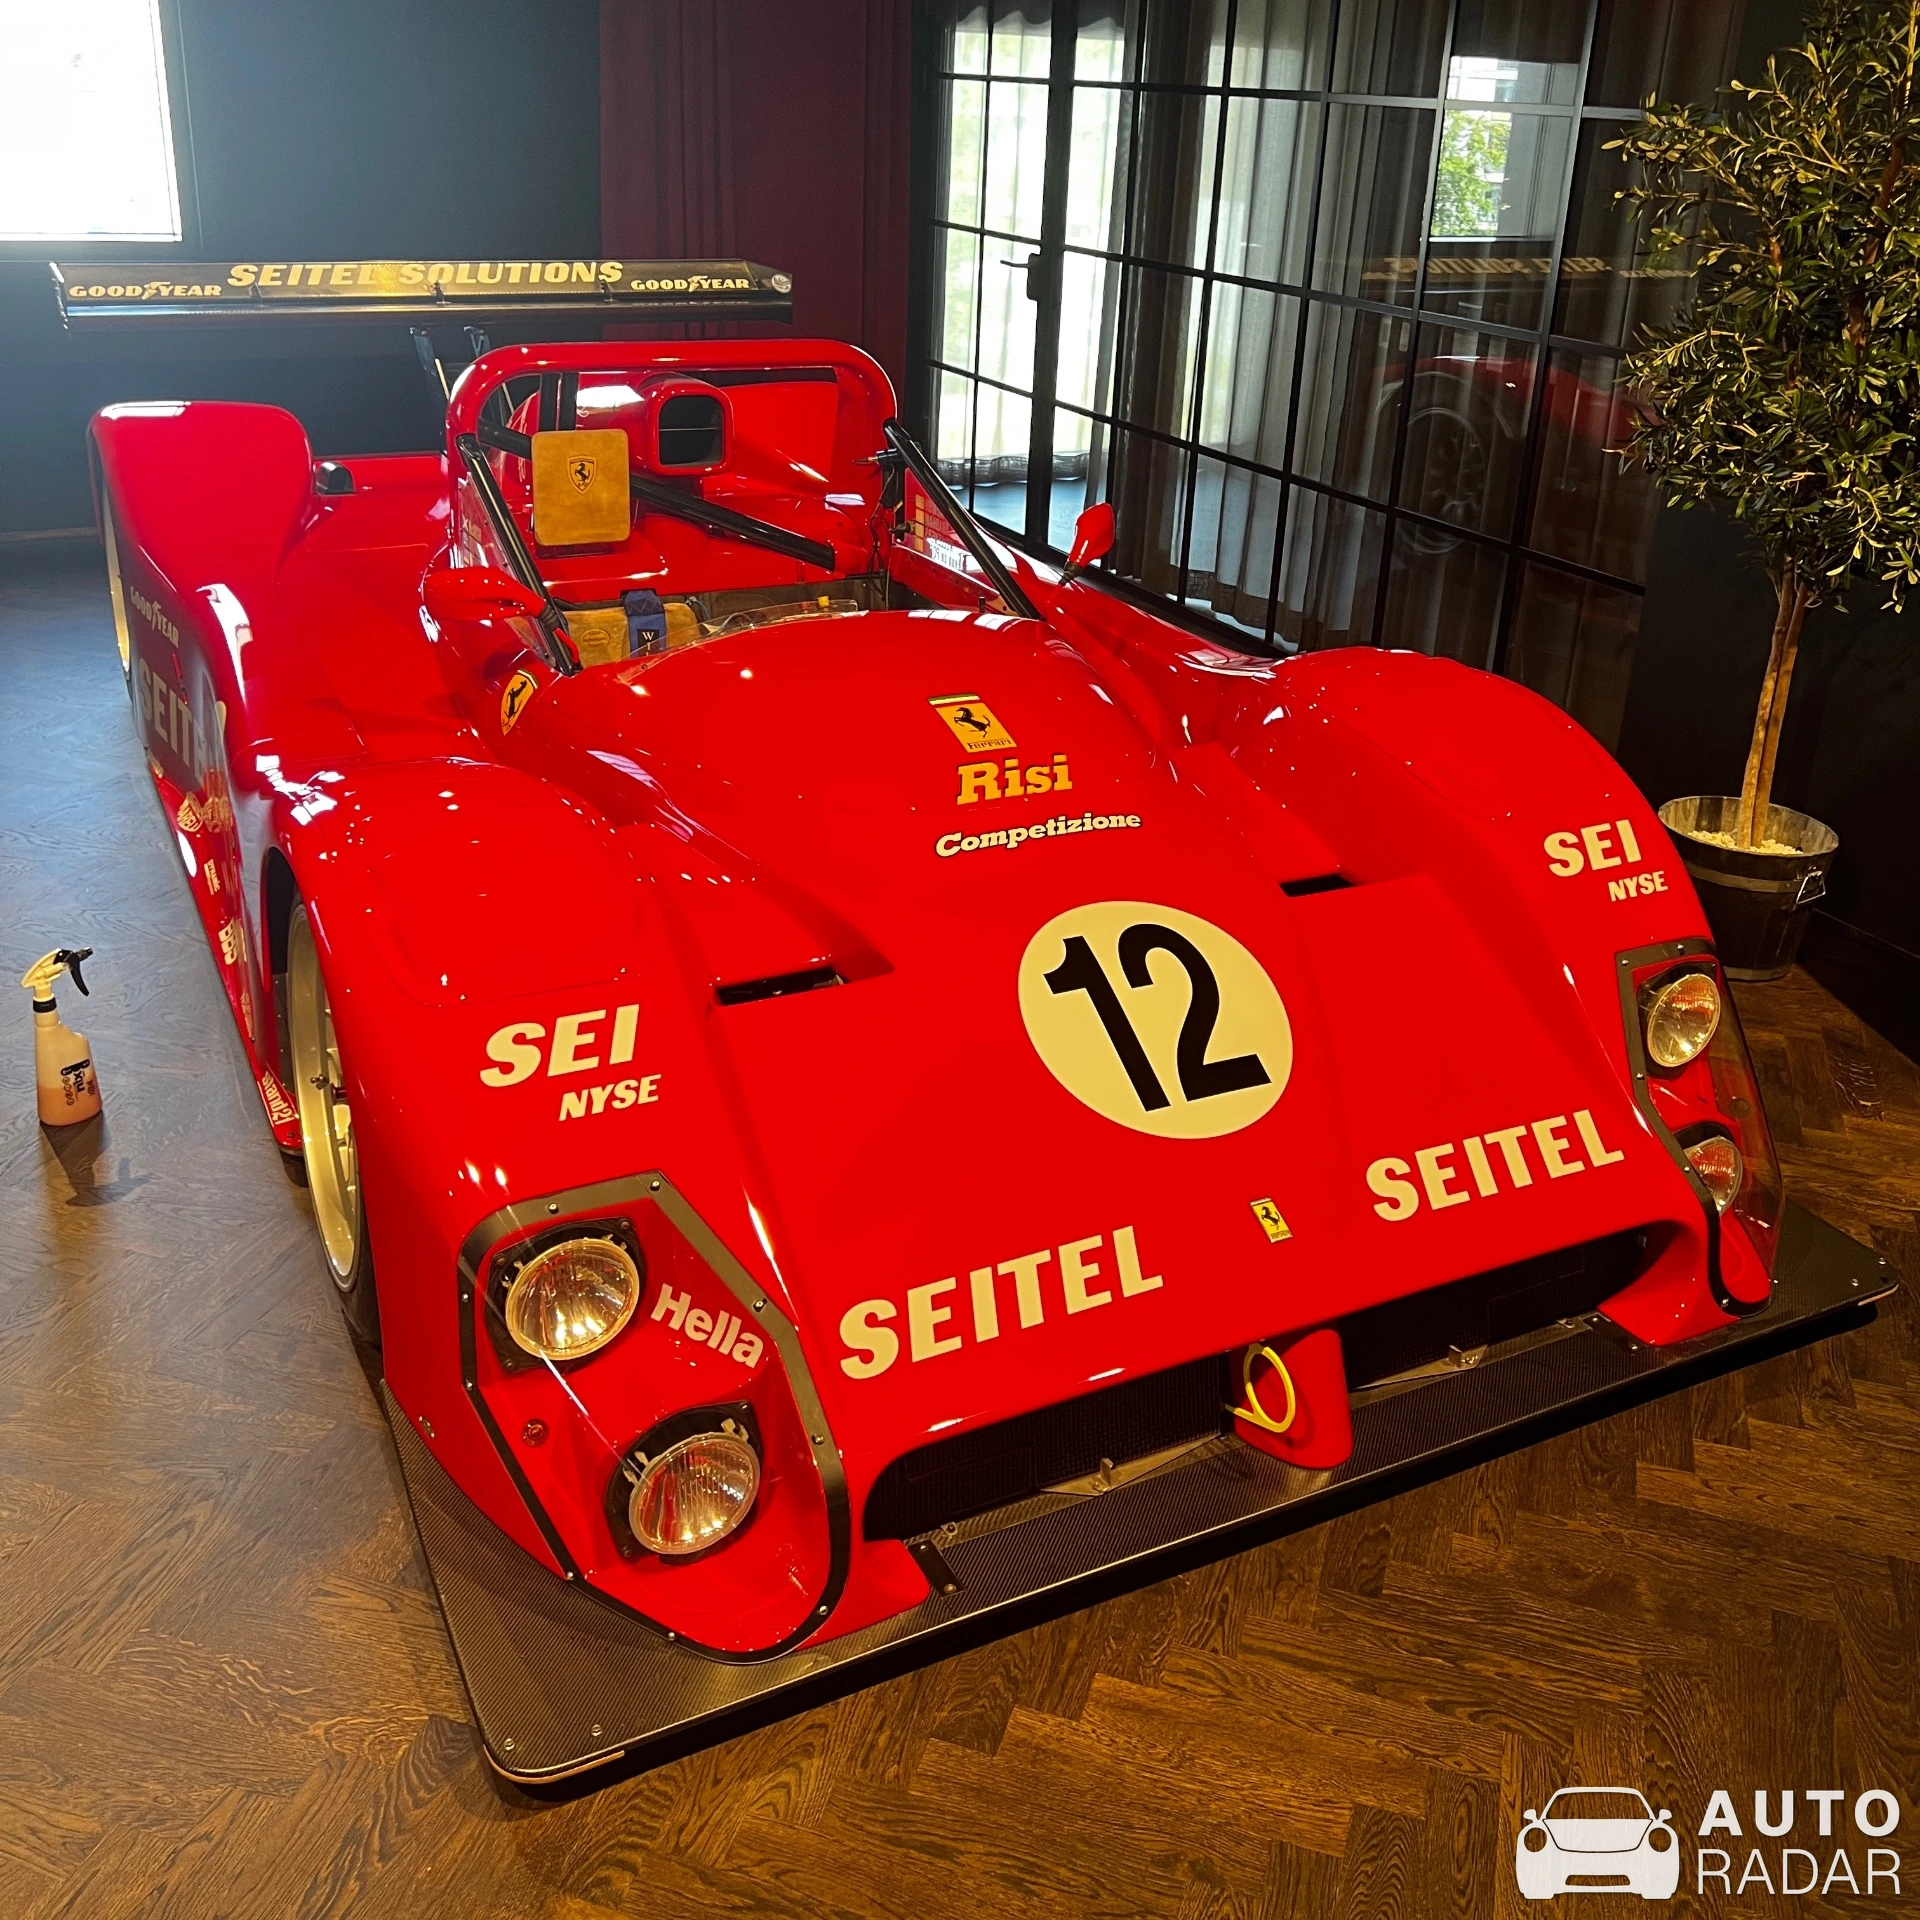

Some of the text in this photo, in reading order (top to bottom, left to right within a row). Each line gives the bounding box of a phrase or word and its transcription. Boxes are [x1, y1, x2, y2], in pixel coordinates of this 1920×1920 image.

[69, 282, 222, 300] GOODYEAR
[227, 261, 624, 287] SEITEL SOLUTIONS
[630, 275, 750, 292] GOODYEAR
[130, 586, 180, 649] GOODYEAR
[966, 738, 1012, 750] Ferrari
[957, 754, 1073, 805] Risi
[936, 813, 1142, 857] Competizione
[1543, 819, 1642, 878] SEI
[1608, 871, 1668, 902] NYSE
[1043, 923, 1272, 1112] 12
[479, 1003, 640, 1088] SEI
[559, 1074, 662, 1121] NYSE
[1366, 1109, 1624, 1221] SEITEL
[650, 1283, 764, 1368] Hella
[839, 1225, 1164, 1380] SEITEL
